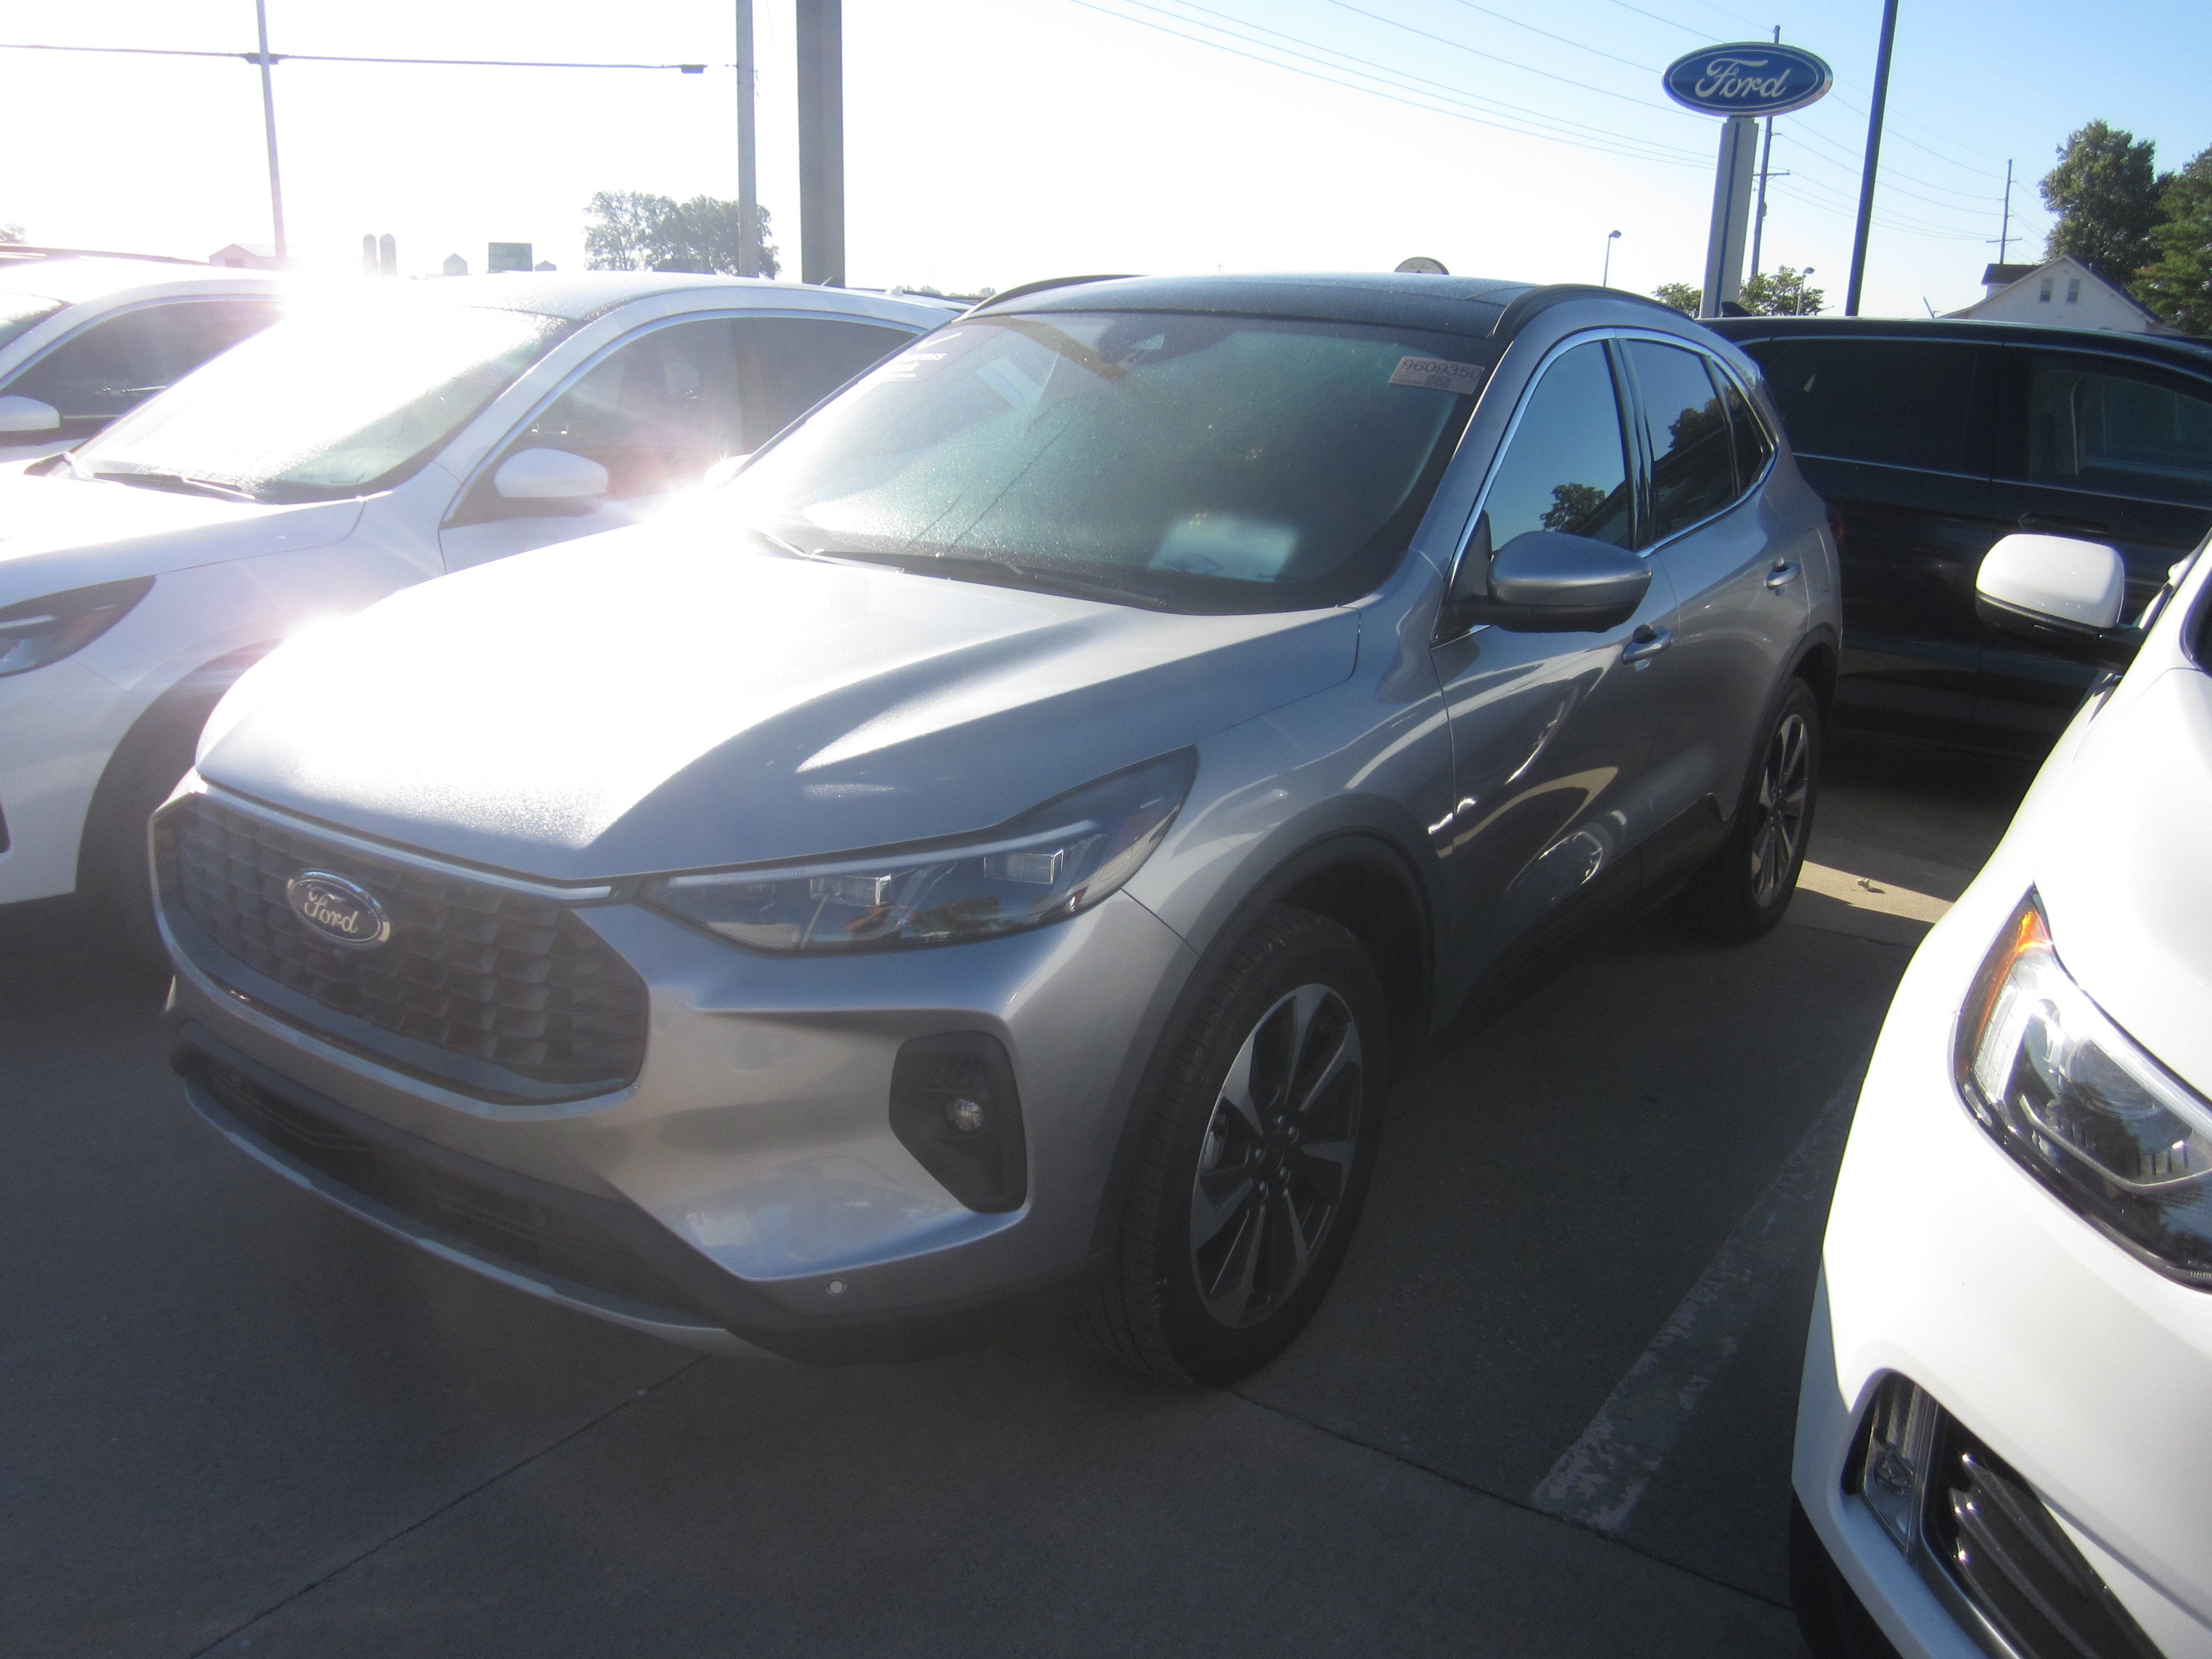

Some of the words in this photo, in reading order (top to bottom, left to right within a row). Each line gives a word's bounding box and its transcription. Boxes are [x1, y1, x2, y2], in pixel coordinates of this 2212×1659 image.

[1694, 58, 1791, 98] Ford
[1401, 359, 1482, 379] 9609350
[304, 885, 358, 933] Ford
